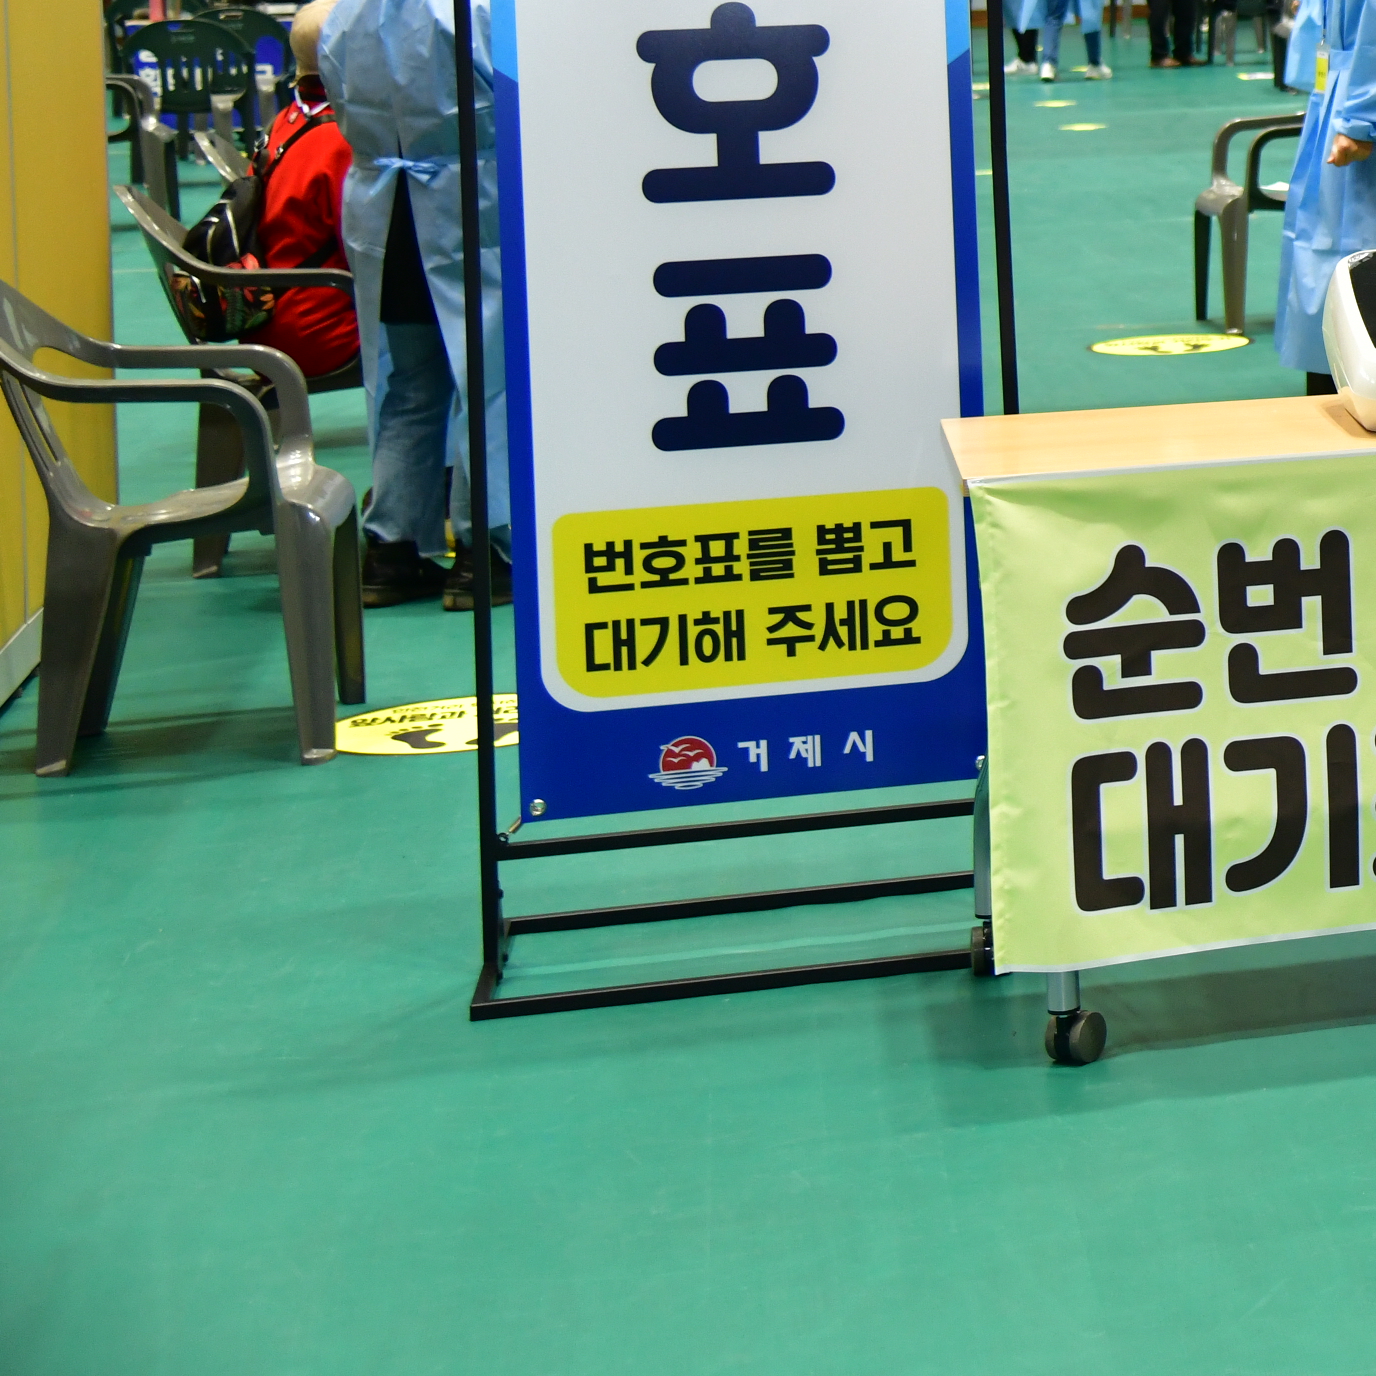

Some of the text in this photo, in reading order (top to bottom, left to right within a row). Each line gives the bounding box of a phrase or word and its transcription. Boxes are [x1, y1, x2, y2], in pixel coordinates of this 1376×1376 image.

[583, 518, 917, 595] 번호표를 뽑고
[584, 594, 922, 674] 대기해 주세요
[1064, 528, 1359, 722] 순번
